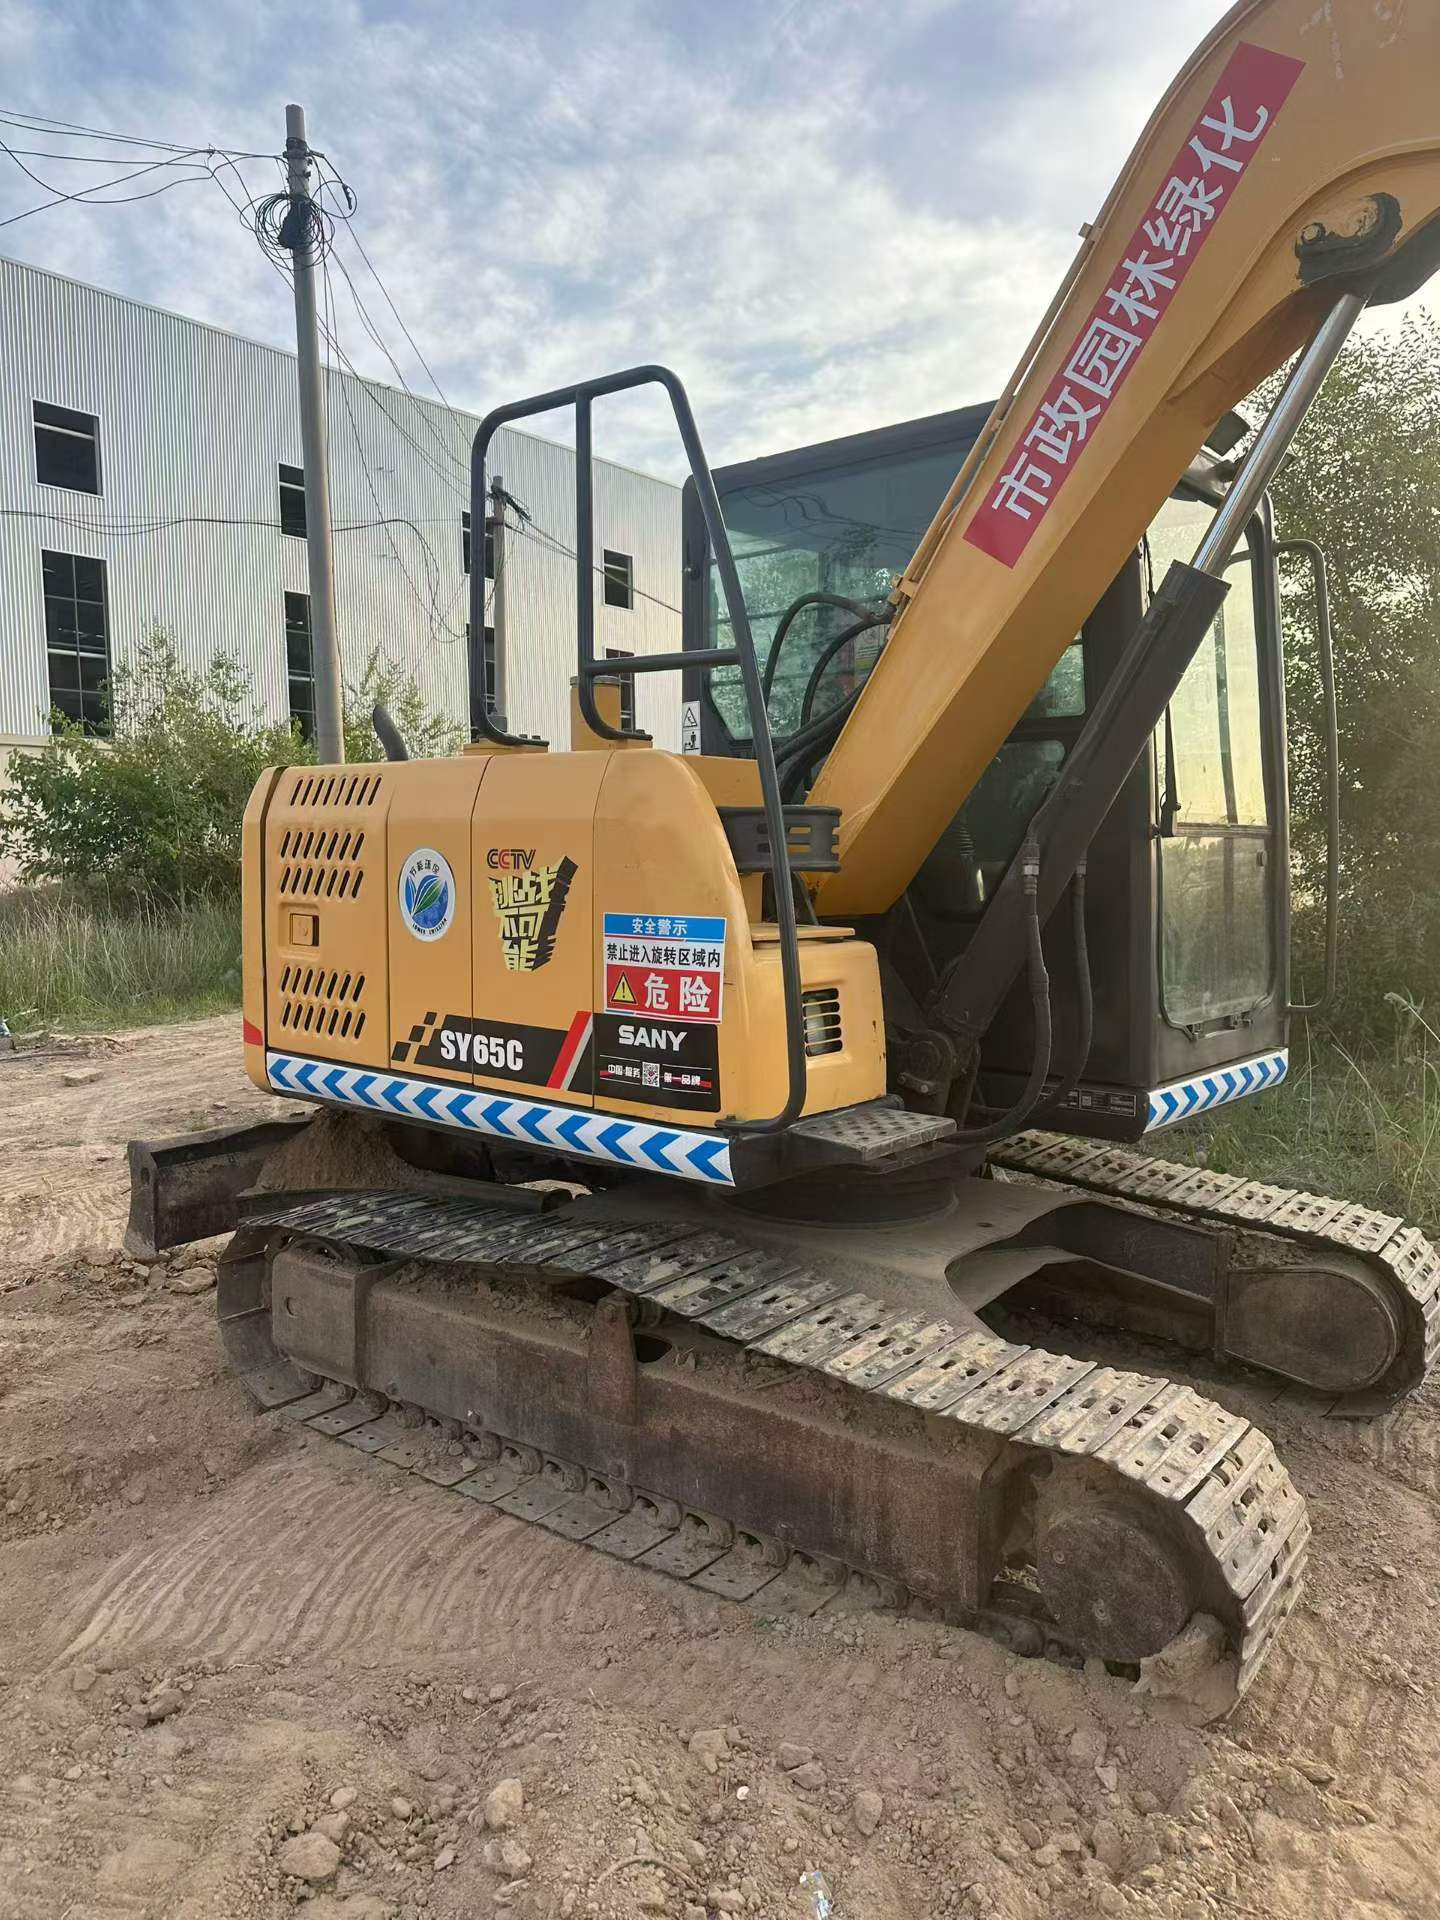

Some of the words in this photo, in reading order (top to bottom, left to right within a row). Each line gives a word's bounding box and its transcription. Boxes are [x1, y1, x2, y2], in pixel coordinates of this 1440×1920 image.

[991, 95, 1268, 520] 市政园林绿化
[487, 848, 536, 870] CCTV
[631, 917, 688, 936] 安全警示
[606, 942, 721, 969] 禁止进入旋转区域内
[644, 971, 712, 1013] 危险
[440, 1029, 524, 1072] SY65C
[618, 1024, 688, 1052] SANY
